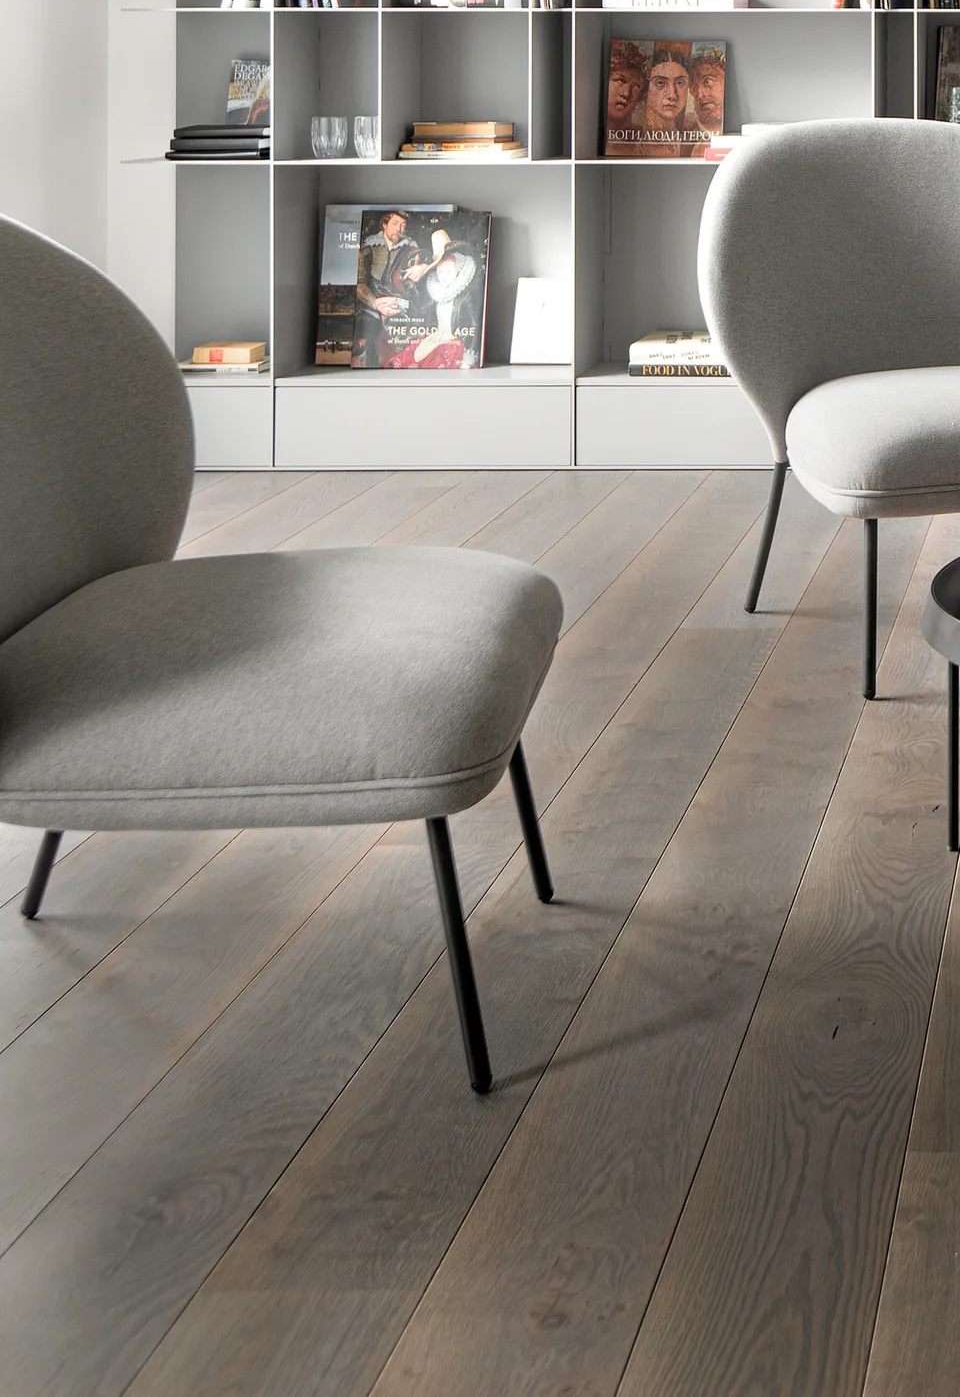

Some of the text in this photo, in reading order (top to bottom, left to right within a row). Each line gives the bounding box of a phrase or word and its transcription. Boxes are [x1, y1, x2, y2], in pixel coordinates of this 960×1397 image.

[234, 63, 268, 72] EDGAR
[233, 72, 267, 80] DEGAS
[608, 129, 642, 141] БОГИ,
[643, 130, 682, 142] ЛЮДИ,
[338, 232, 358, 241] THE
[387, 326, 407, 335] THE
[454, 327, 475, 336] AGE
[642, 365, 675, 376] FOOD
[677, 365, 691, 376] IN
